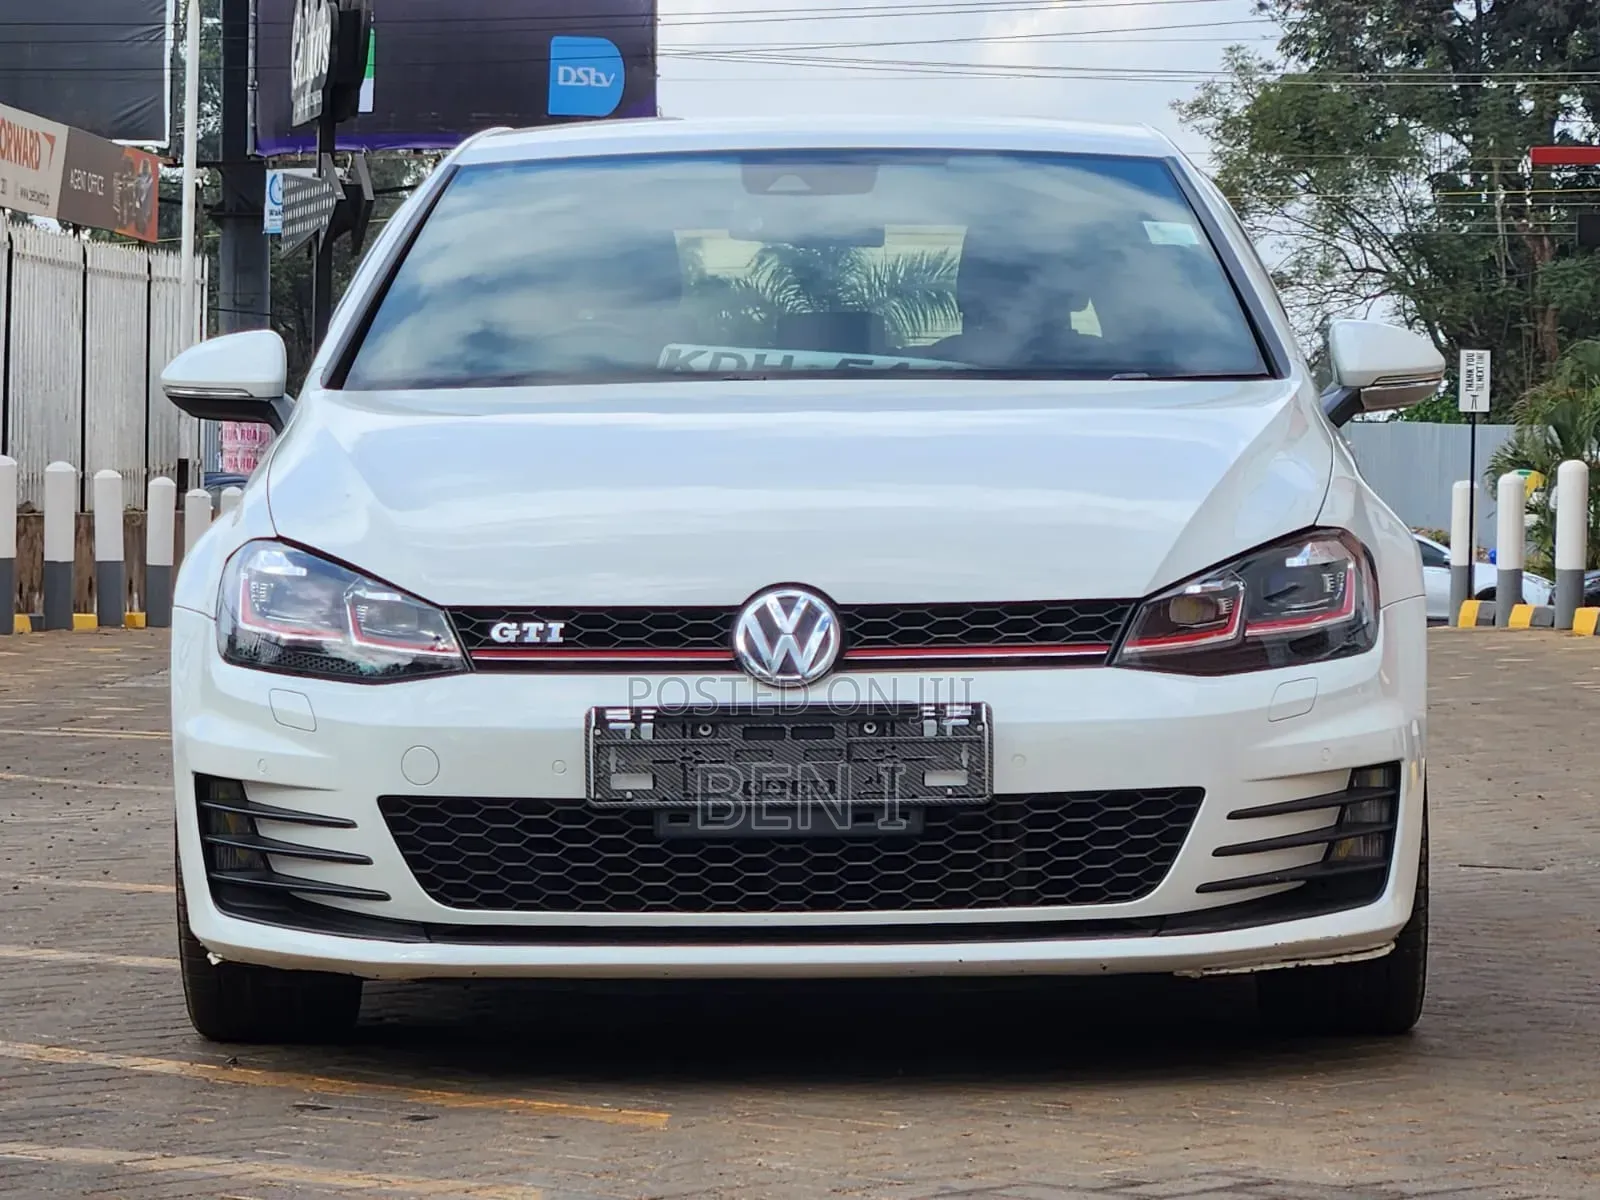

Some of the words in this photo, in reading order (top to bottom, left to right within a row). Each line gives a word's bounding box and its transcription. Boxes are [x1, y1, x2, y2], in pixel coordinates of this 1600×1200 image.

[1465, 353, 1475, 366] YOU
[1465, 369, 1475, 392] THANK
[1476, 366, 1484, 382] NEXT
[491, 622, 565, 643] GTI
